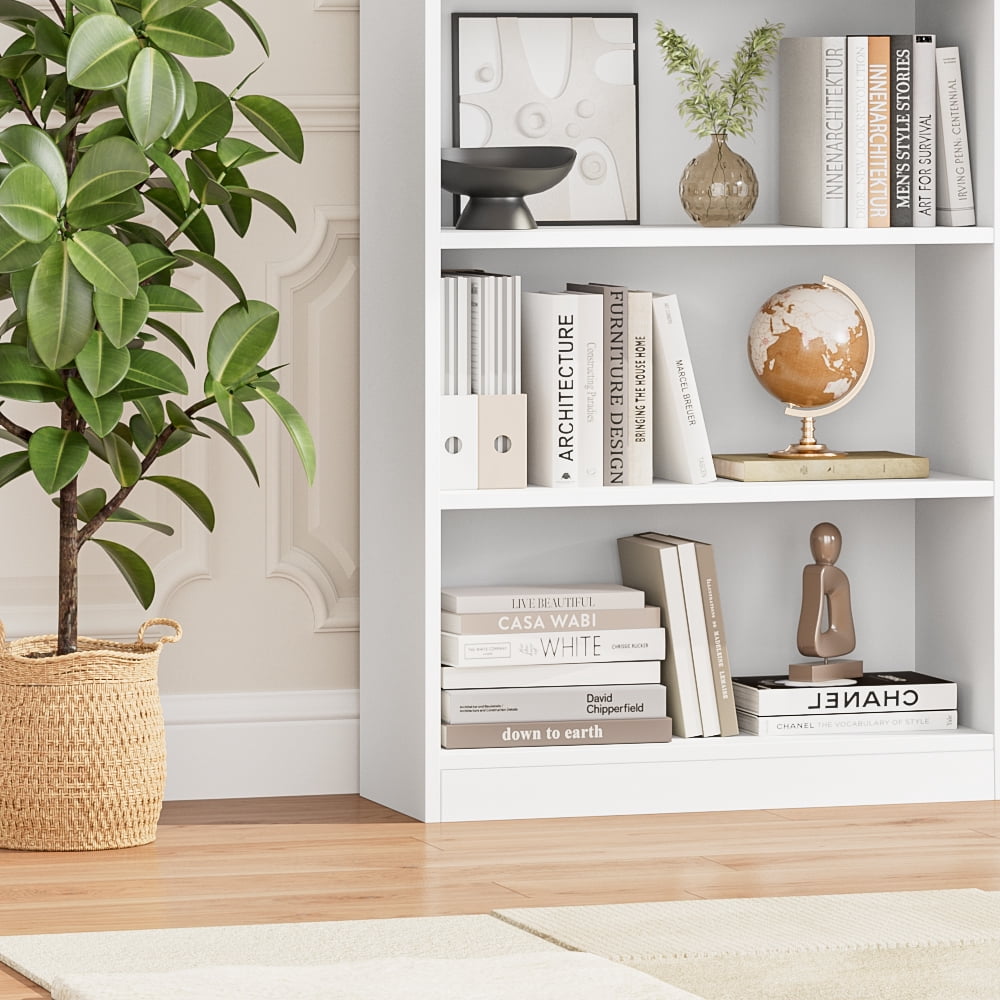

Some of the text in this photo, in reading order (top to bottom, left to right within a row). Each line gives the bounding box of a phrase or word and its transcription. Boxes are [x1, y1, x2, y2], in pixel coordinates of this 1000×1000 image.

[826, 48, 843, 200] INNENARCHITEKTUR
[869, 64, 888, 216] INNENARCHITEKTUR
[896, 49, 910, 208] MEN'S STYLE STORIES
[947, 79, 967, 200] IRVING CENTENNIAL
[919, 114, 931, 216] ART FOR SURVIVAL
[558, 314, 573, 461] ARCHITECTURE
[585, 342, 596, 389] Constructing
[610, 291, 623, 484] FURNITURE DESIGN
[635, 336, 646, 443] BRINGING THE HOUSE HOME
[676, 360, 696, 426] MARCEL BREUER
[498, 613, 596, 630] CASA WABI
[512, 597, 596, 609] LIVE BEAUTIFUL
[540, 636, 601, 657] WHITE
[586, 693, 613, 703] David
[586, 703, 644, 716] Chipperfield
[835, 719, 890, 727] VOCABULARY
[502, 725, 603, 741] down to earth
